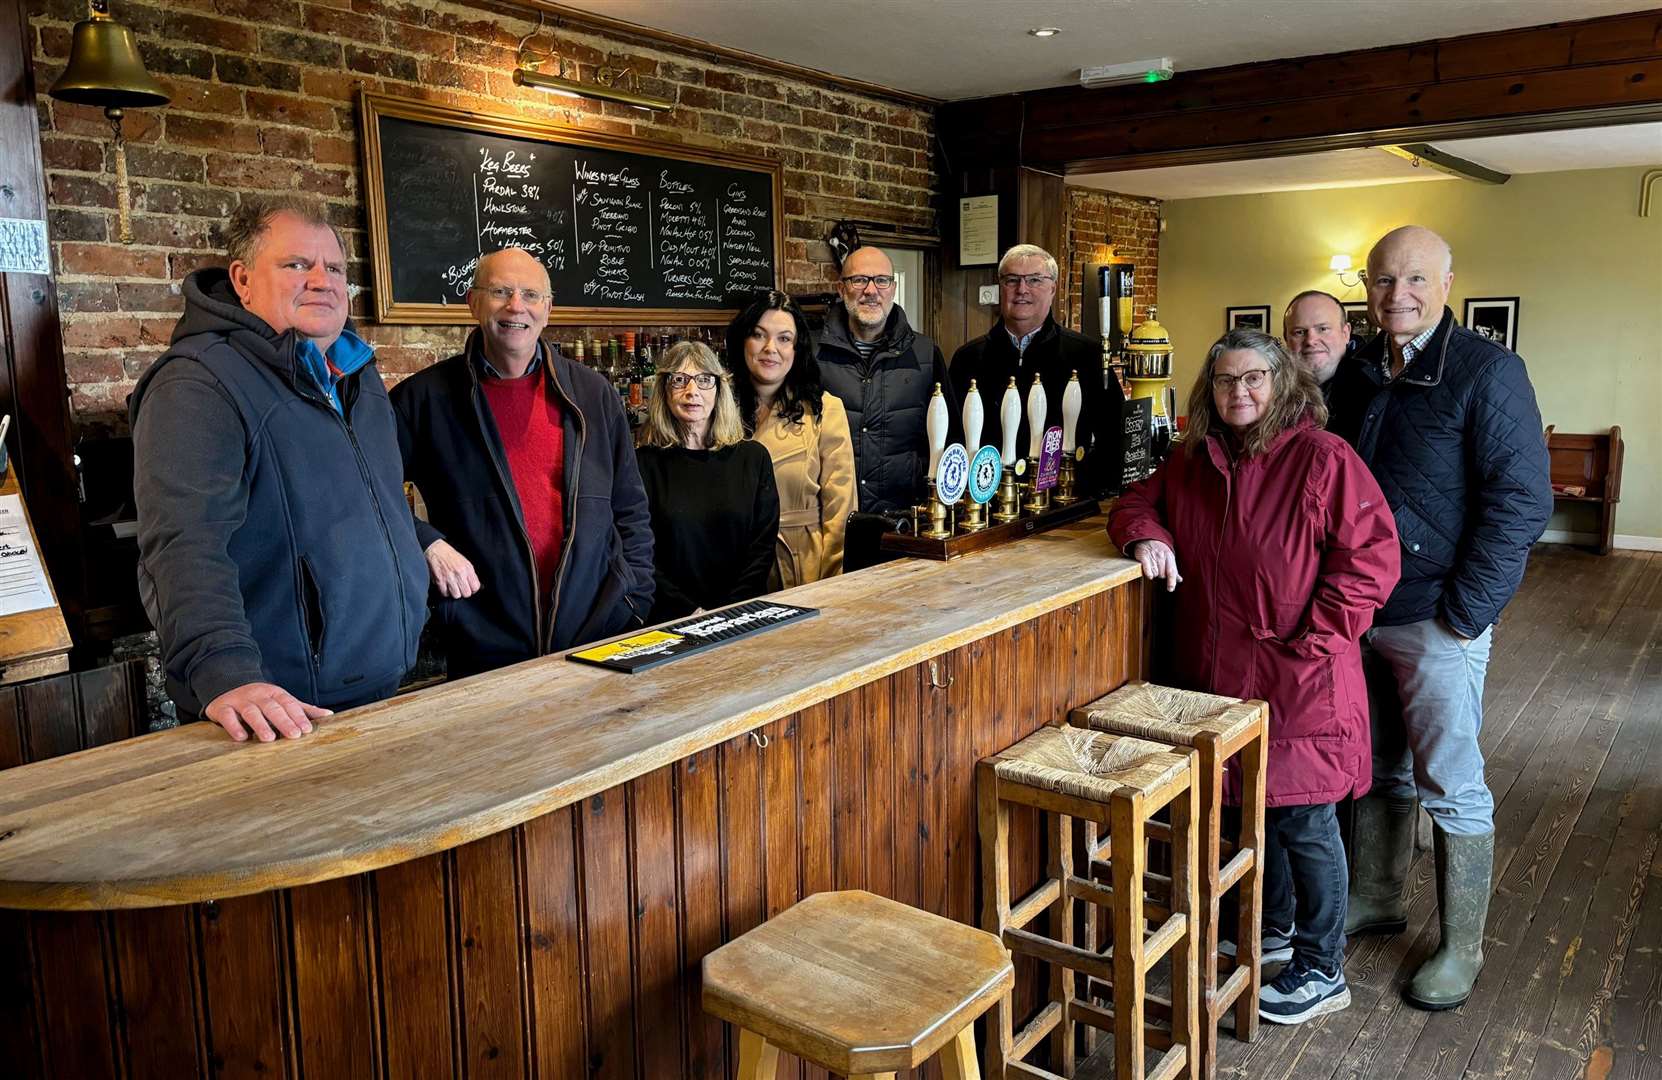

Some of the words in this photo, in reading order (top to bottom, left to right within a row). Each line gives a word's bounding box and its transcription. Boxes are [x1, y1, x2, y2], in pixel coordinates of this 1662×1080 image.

[574, 160, 600, 180] WINES
[619, 167, 640, 186] GLASS
[660, 170, 694, 193] BOTTLES
[727, 182, 746, 199] GINS
[592, 217, 612, 230] PINOT
